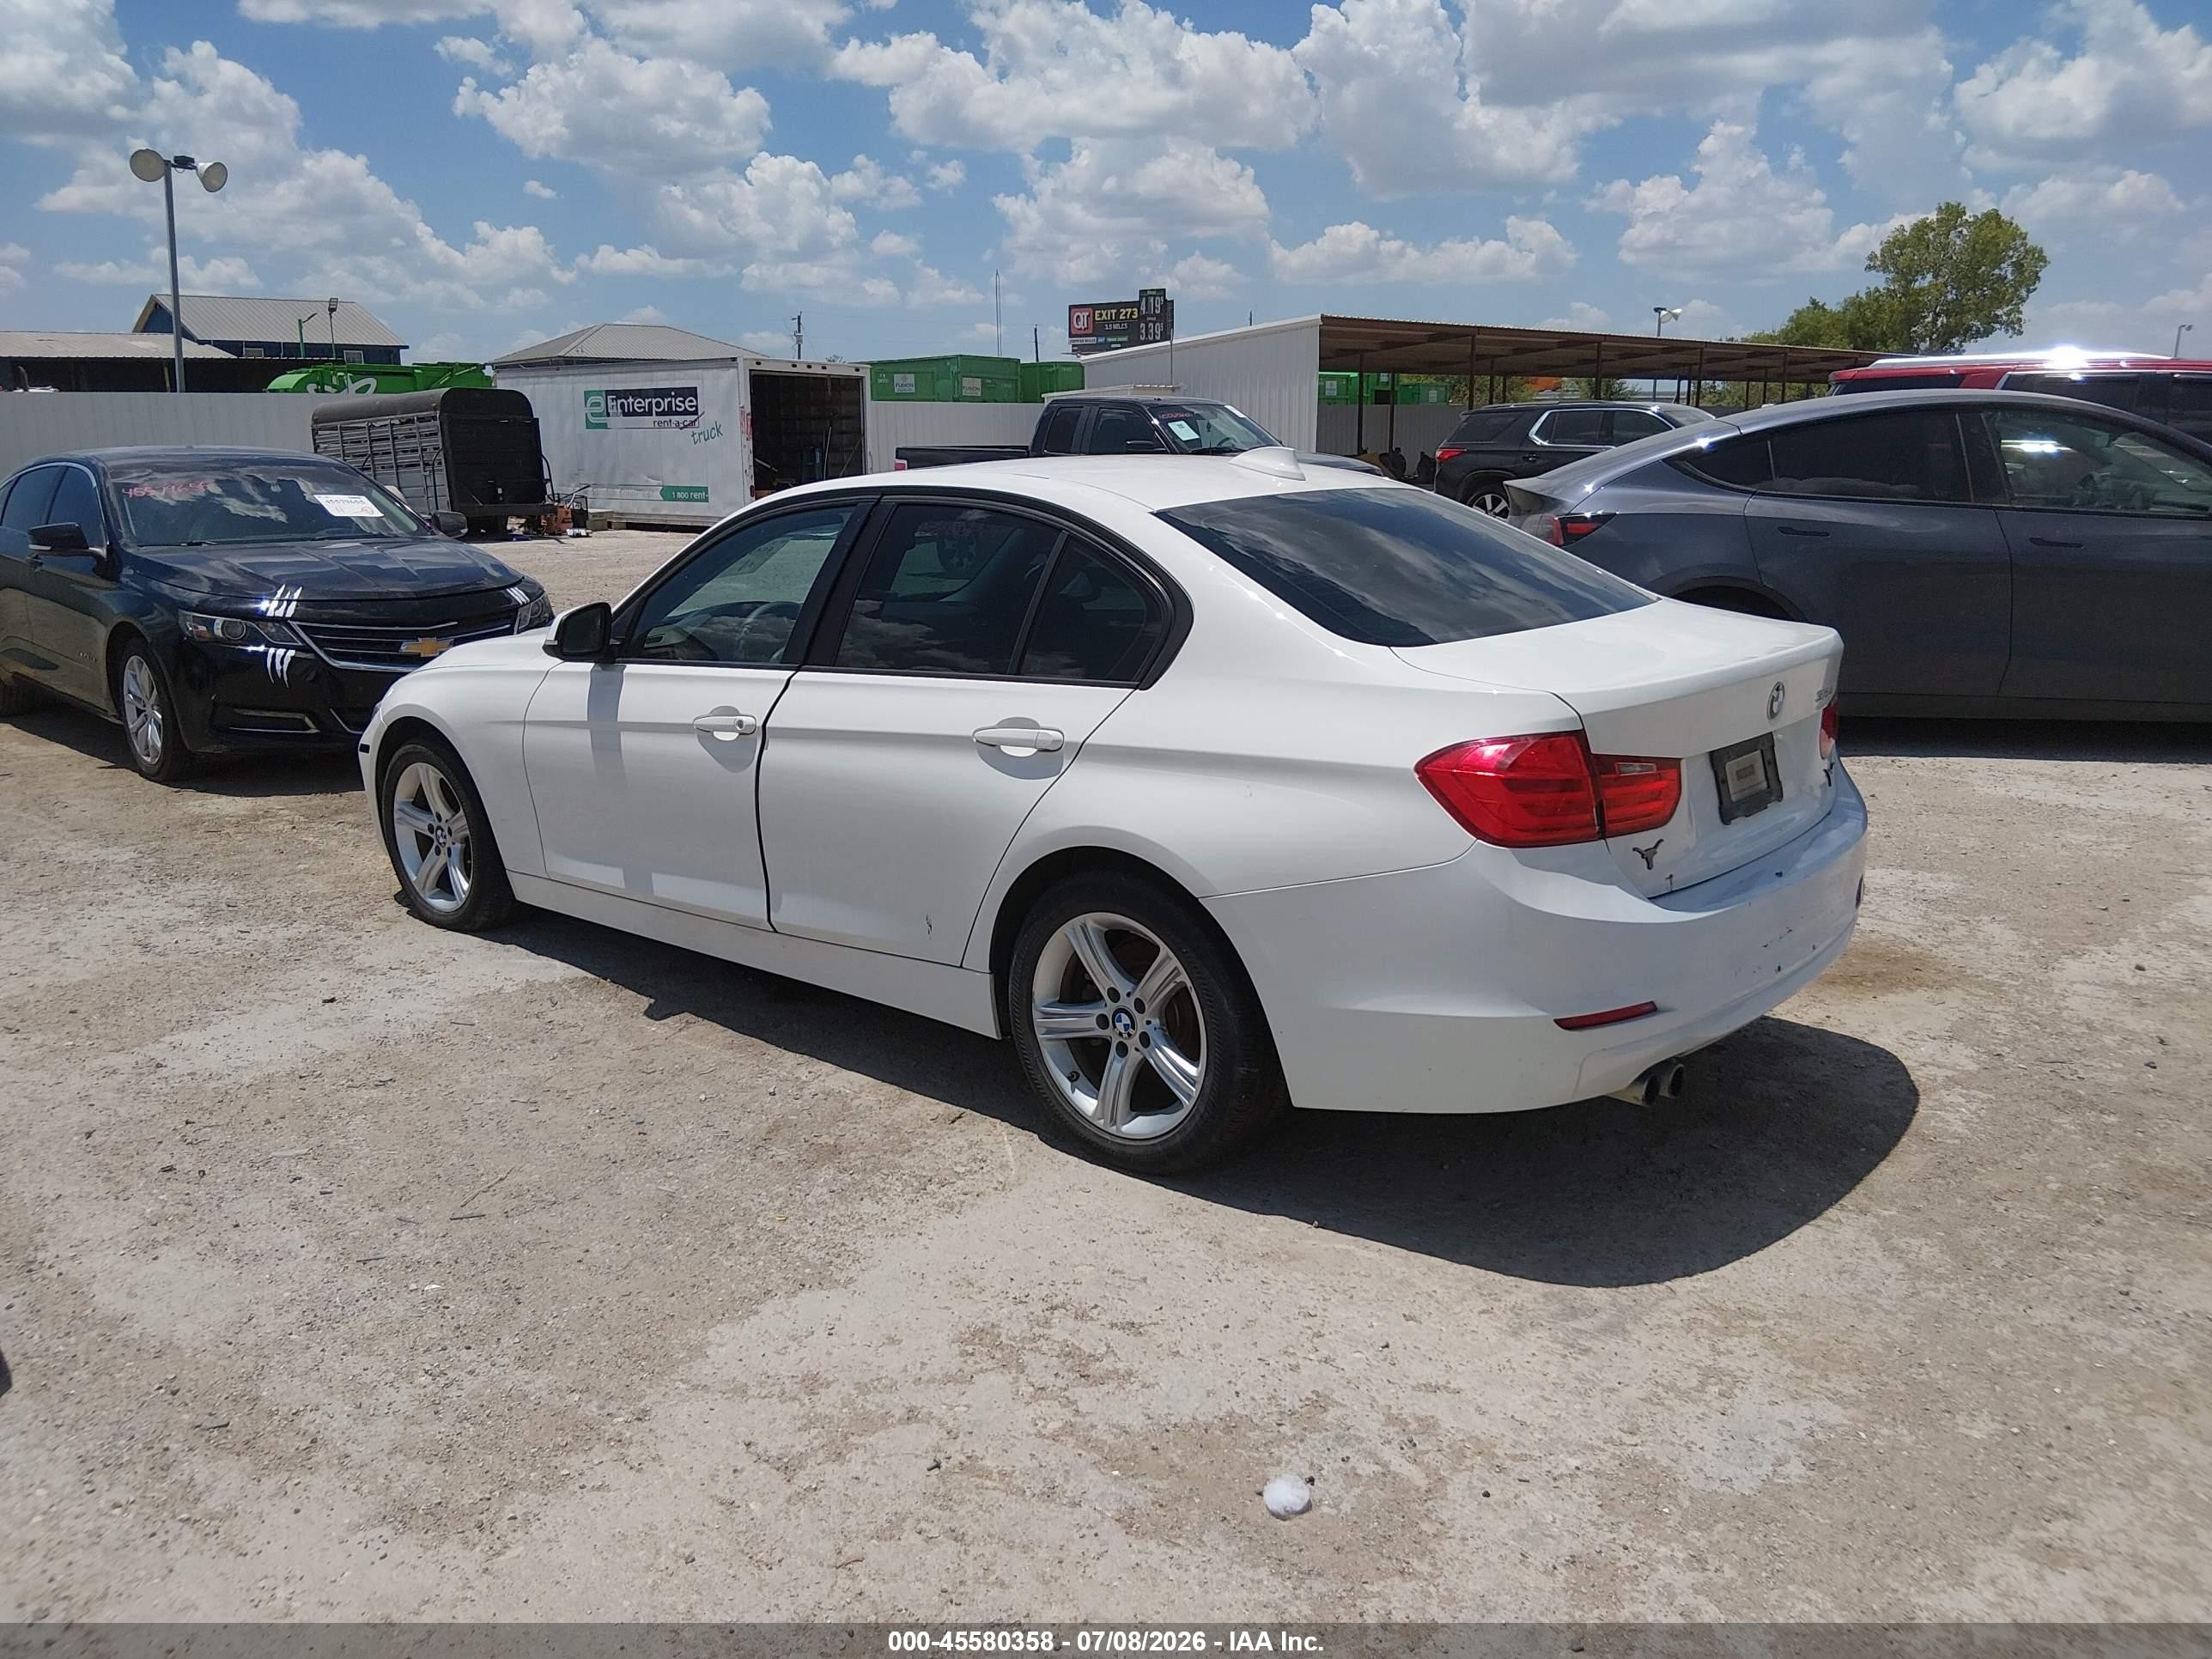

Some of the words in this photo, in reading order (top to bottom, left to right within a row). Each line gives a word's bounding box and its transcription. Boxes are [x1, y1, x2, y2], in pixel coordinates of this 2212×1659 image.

[1073, 312, 1090, 330] QT
[1095, 310, 1116, 321] EXIT
[1119, 308, 1138, 319] 273
[606, 392, 697, 417] Enterprise
[653, 417, 697, 428] rent-a-car
[690, 421, 723, 445] truck
